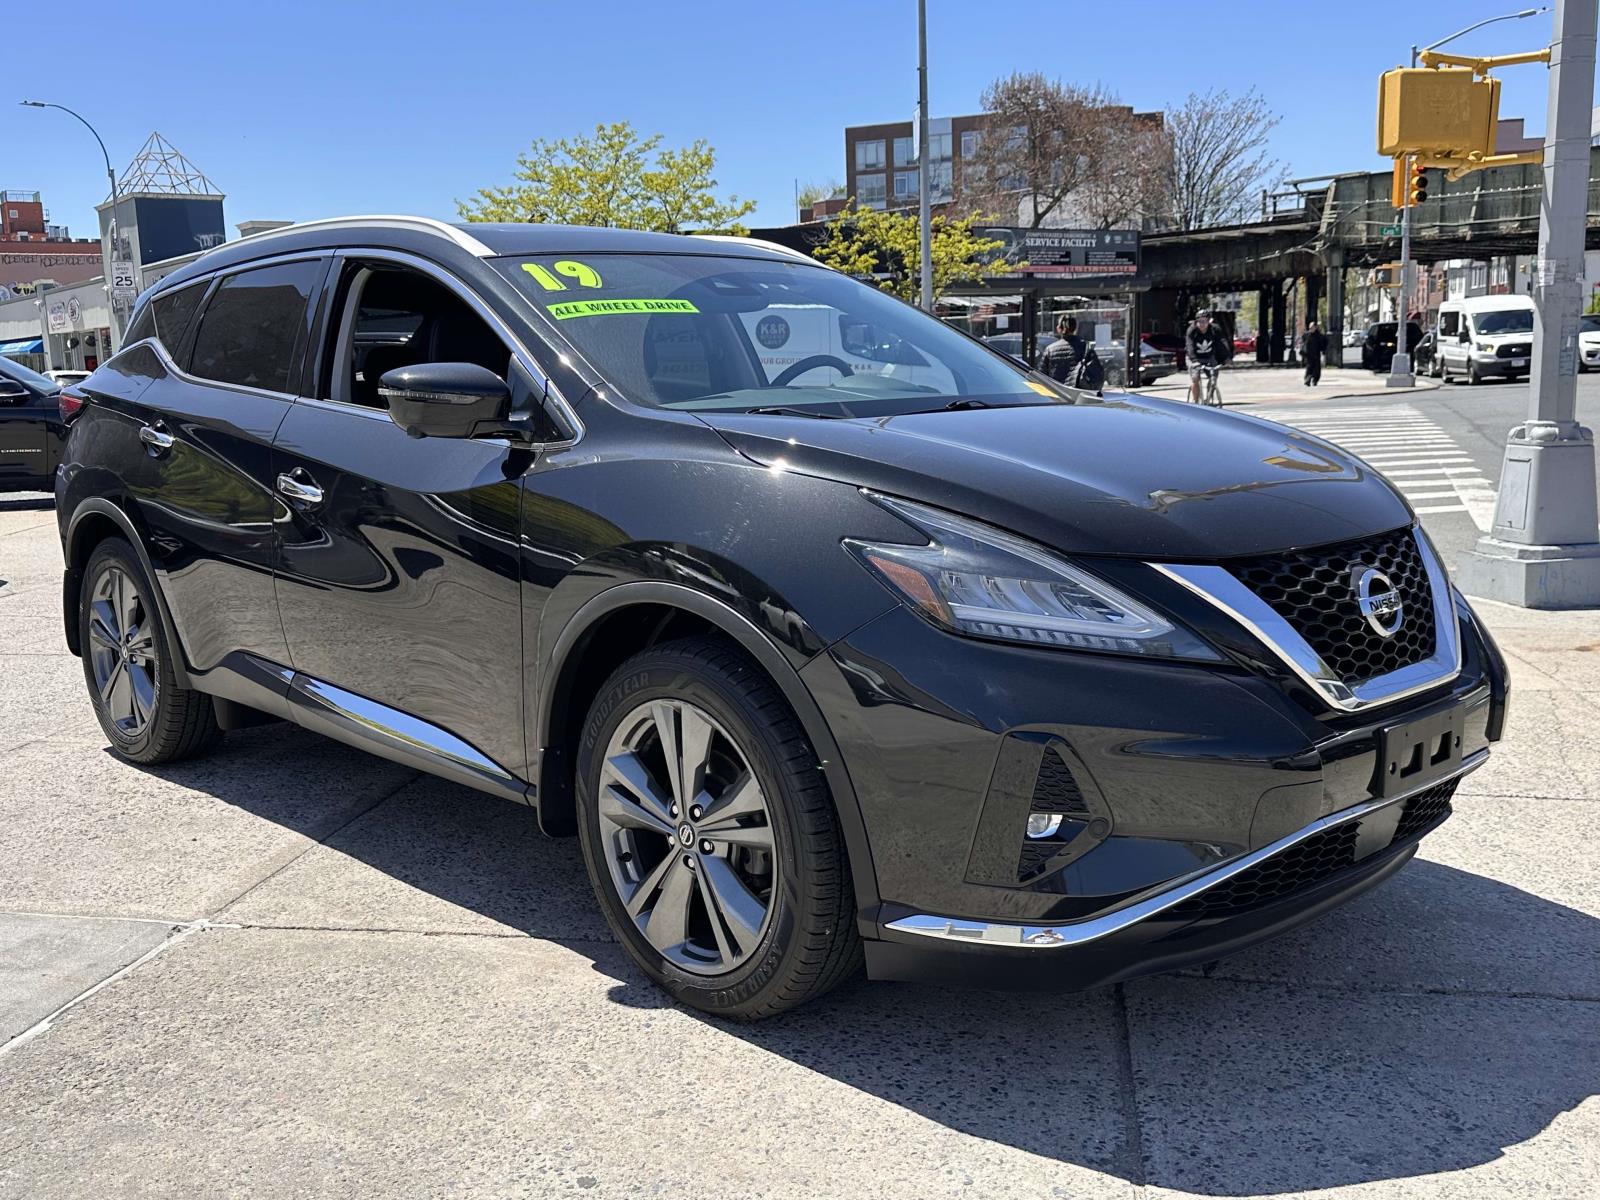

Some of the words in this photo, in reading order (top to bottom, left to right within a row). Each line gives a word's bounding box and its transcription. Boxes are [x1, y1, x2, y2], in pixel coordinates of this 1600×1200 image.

[1025, 238, 1060, 247] SERVICE
[1061, 239, 1097, 247] FACILITY
[115, 276, 133, 286] 25
[521, 261, 603, 291] 19
[555, 304, 583, 316] ALL
[585, 301, 642, 312] WHEEL
[644, 301, 694, 310] DRIVE
[760, 323, 786, 335] K&R
[586, 672, 649, 749] GOODYEAR
